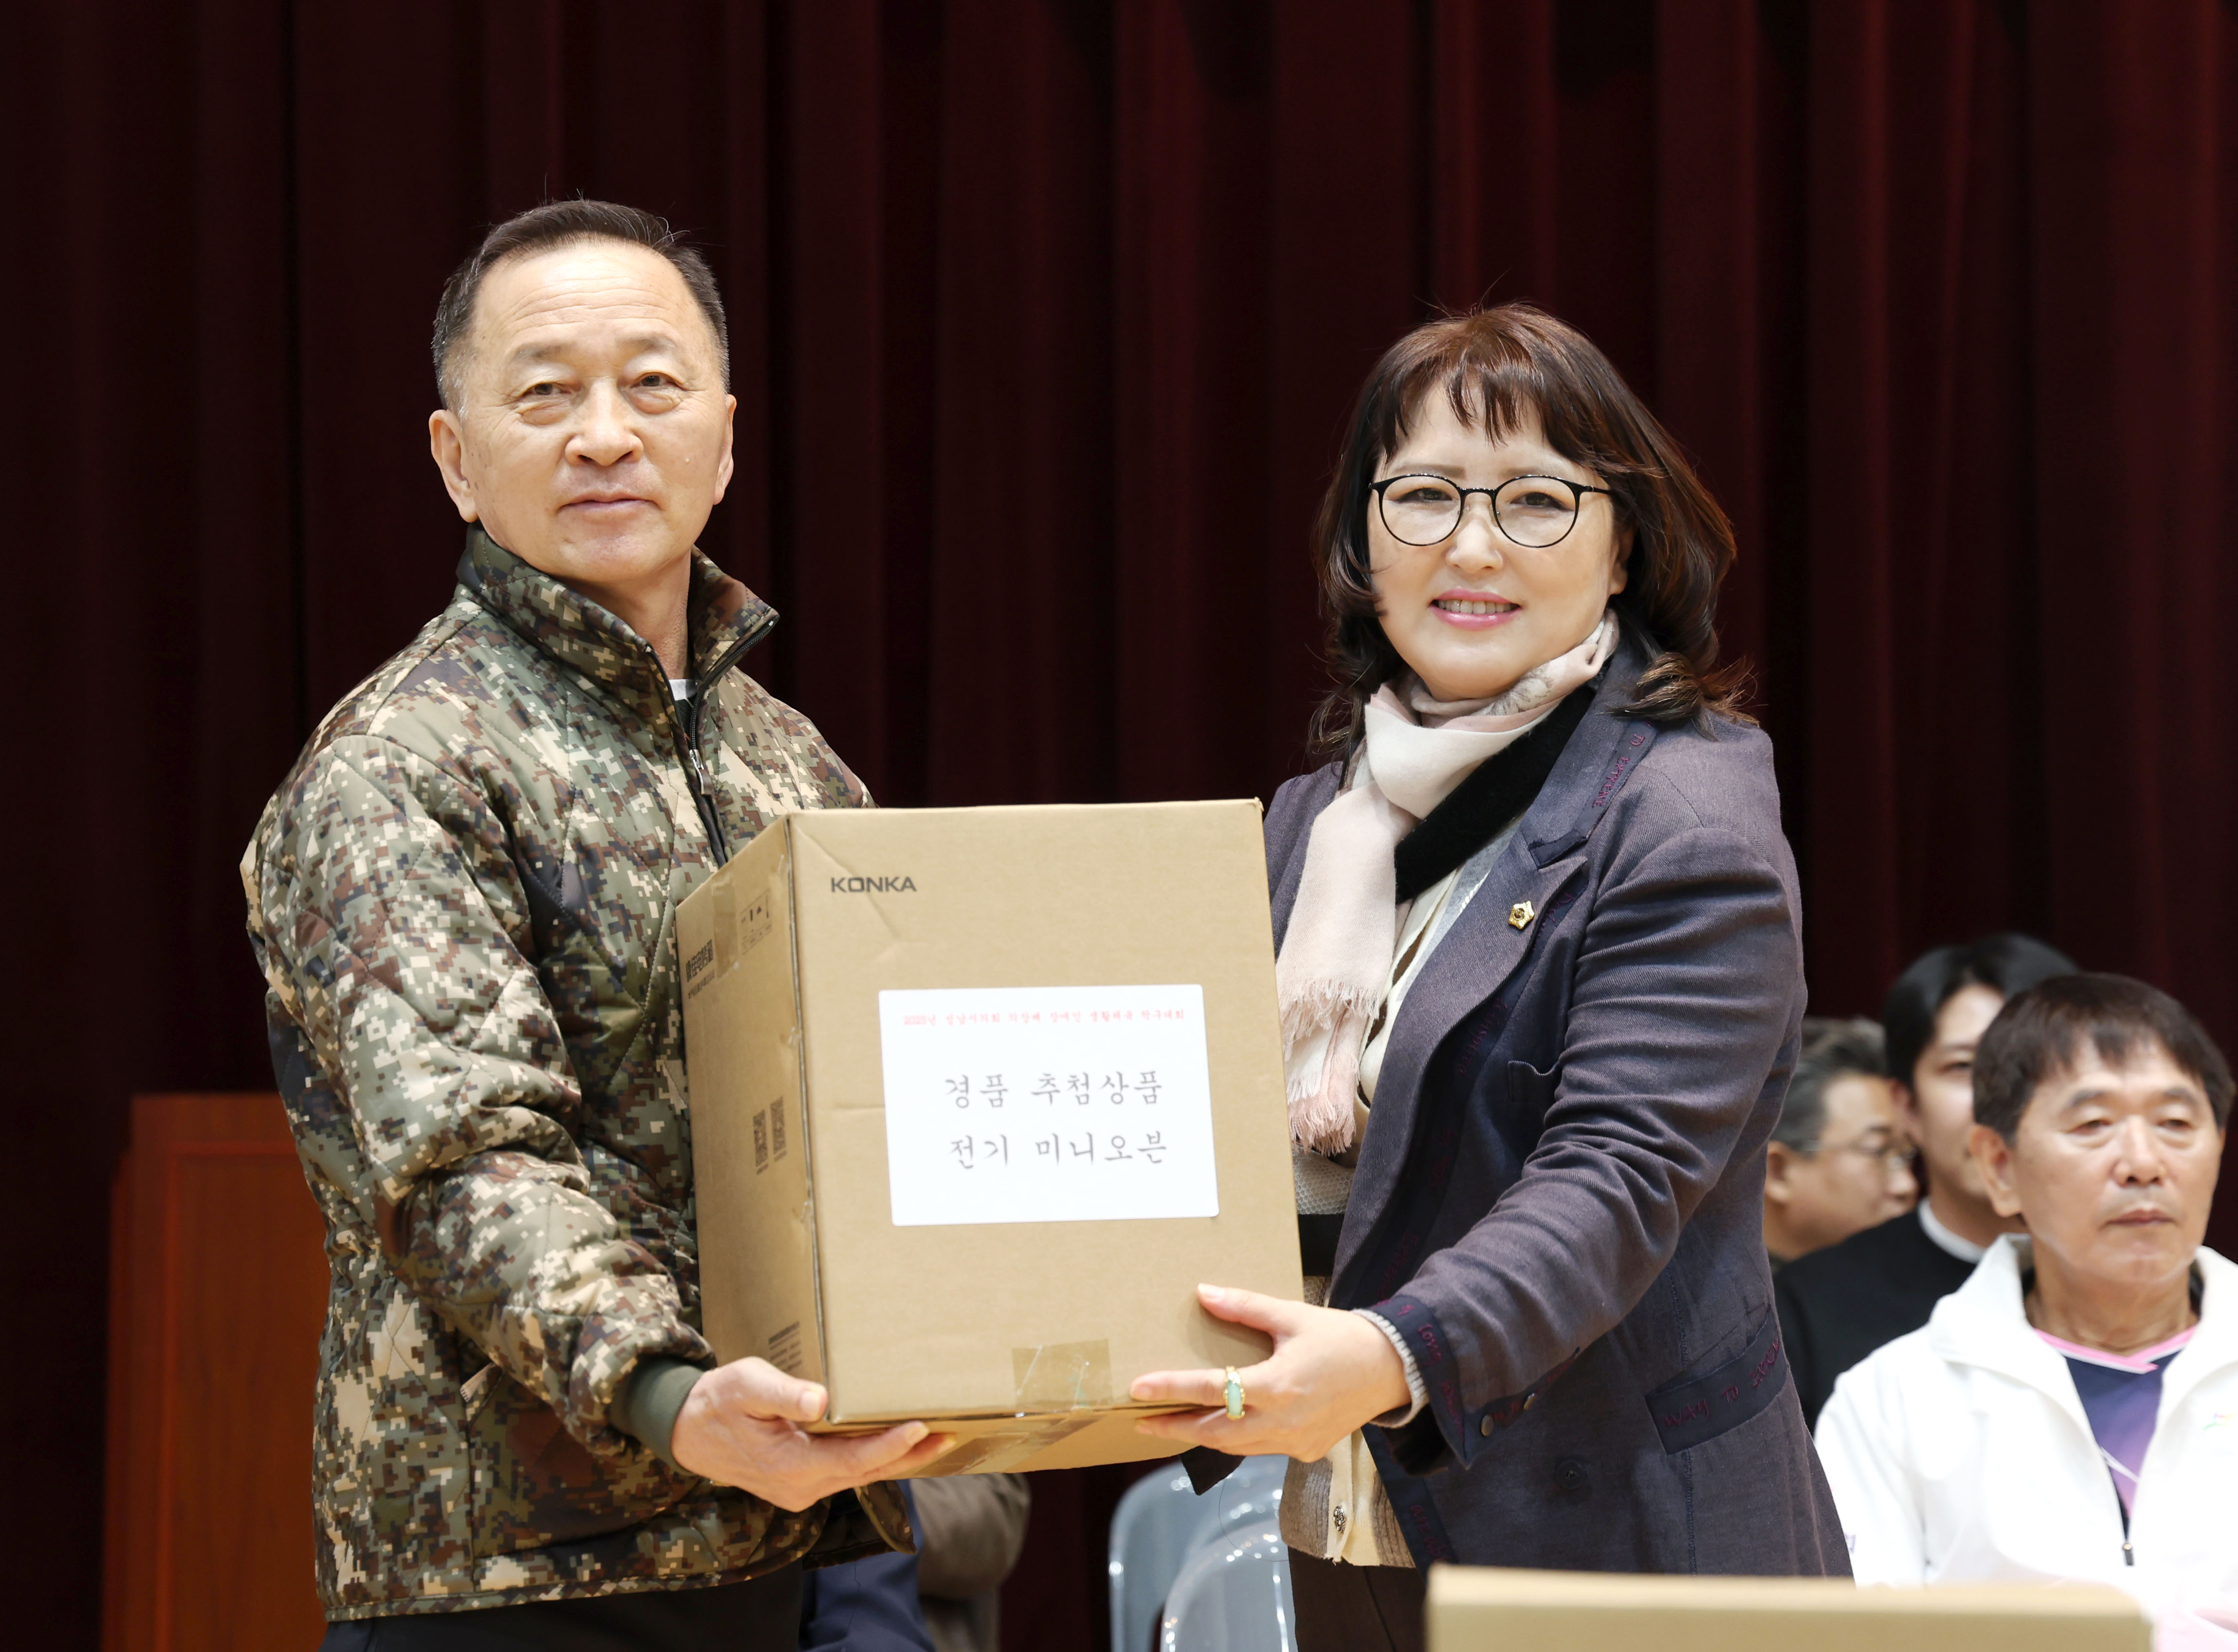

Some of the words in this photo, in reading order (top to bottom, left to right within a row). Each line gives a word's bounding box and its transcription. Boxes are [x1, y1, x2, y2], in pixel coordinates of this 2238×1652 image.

[831, 876, 917, 892] KONKA
[945, 1074, 1009, 1108] 경품
[1030, 1071, 1163, 1105] 추첨상품
[948, 1134, 1008, 1169] 전기
[1034, 1130, 1167, 1165] 미니오븐
